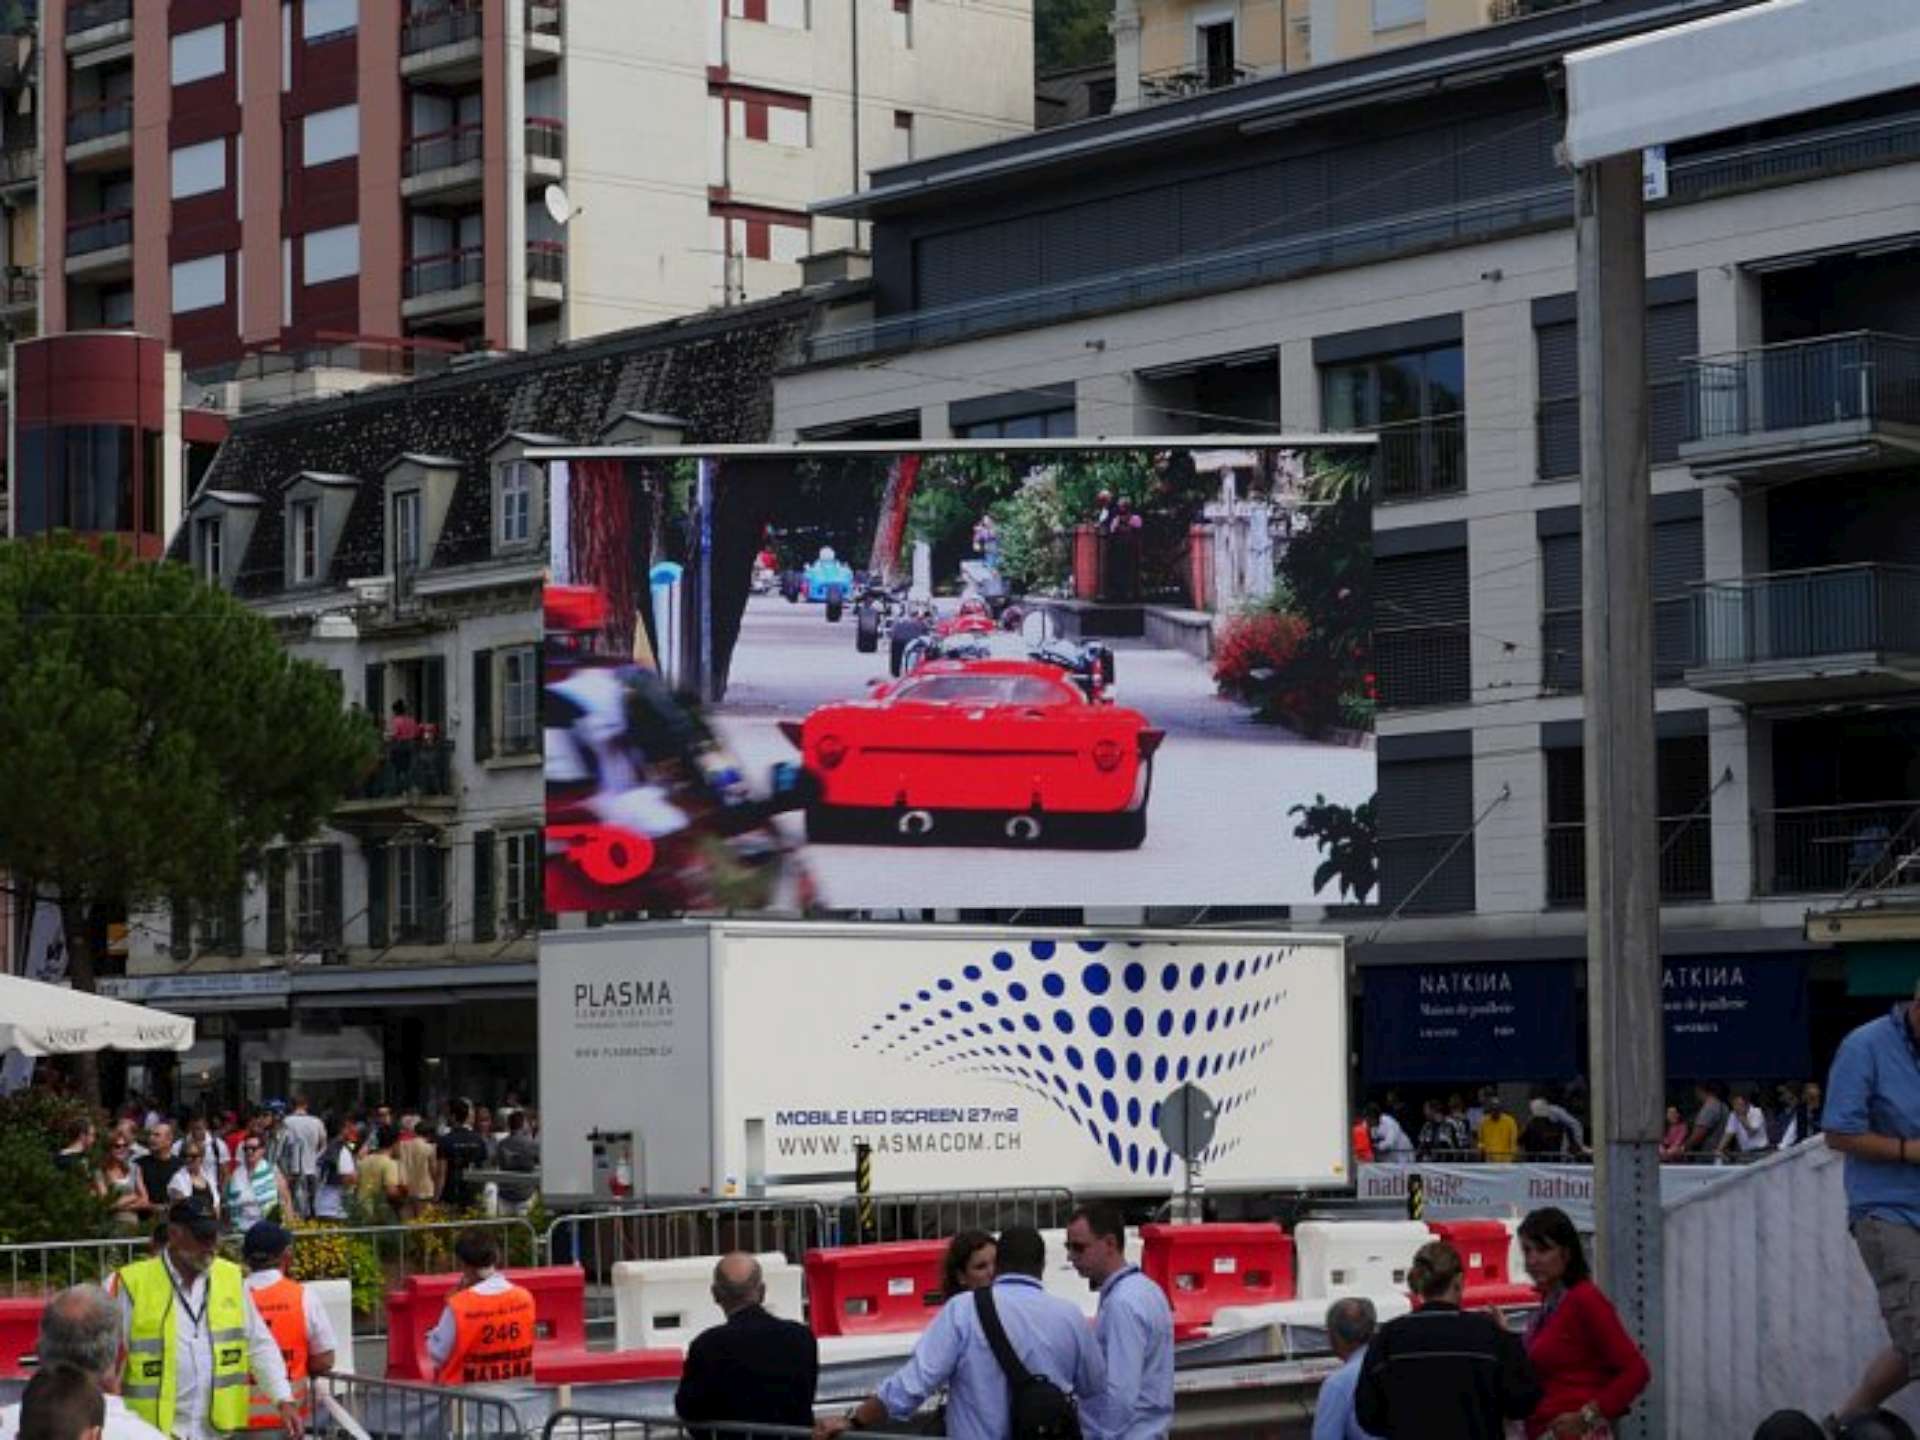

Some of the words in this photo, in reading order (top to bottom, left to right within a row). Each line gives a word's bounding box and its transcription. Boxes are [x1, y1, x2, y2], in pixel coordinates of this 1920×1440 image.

[575, 979, 673, 1007] PLASMA
[776, 1110, 848, 1126] MOBILE
[852, 1110, 887, 1125] LED
[890, 1109, 964, 1125] SCREEN
[968, 1107, 1019, 1123] 27m2
[481, 1321, 521, 1345] 246
